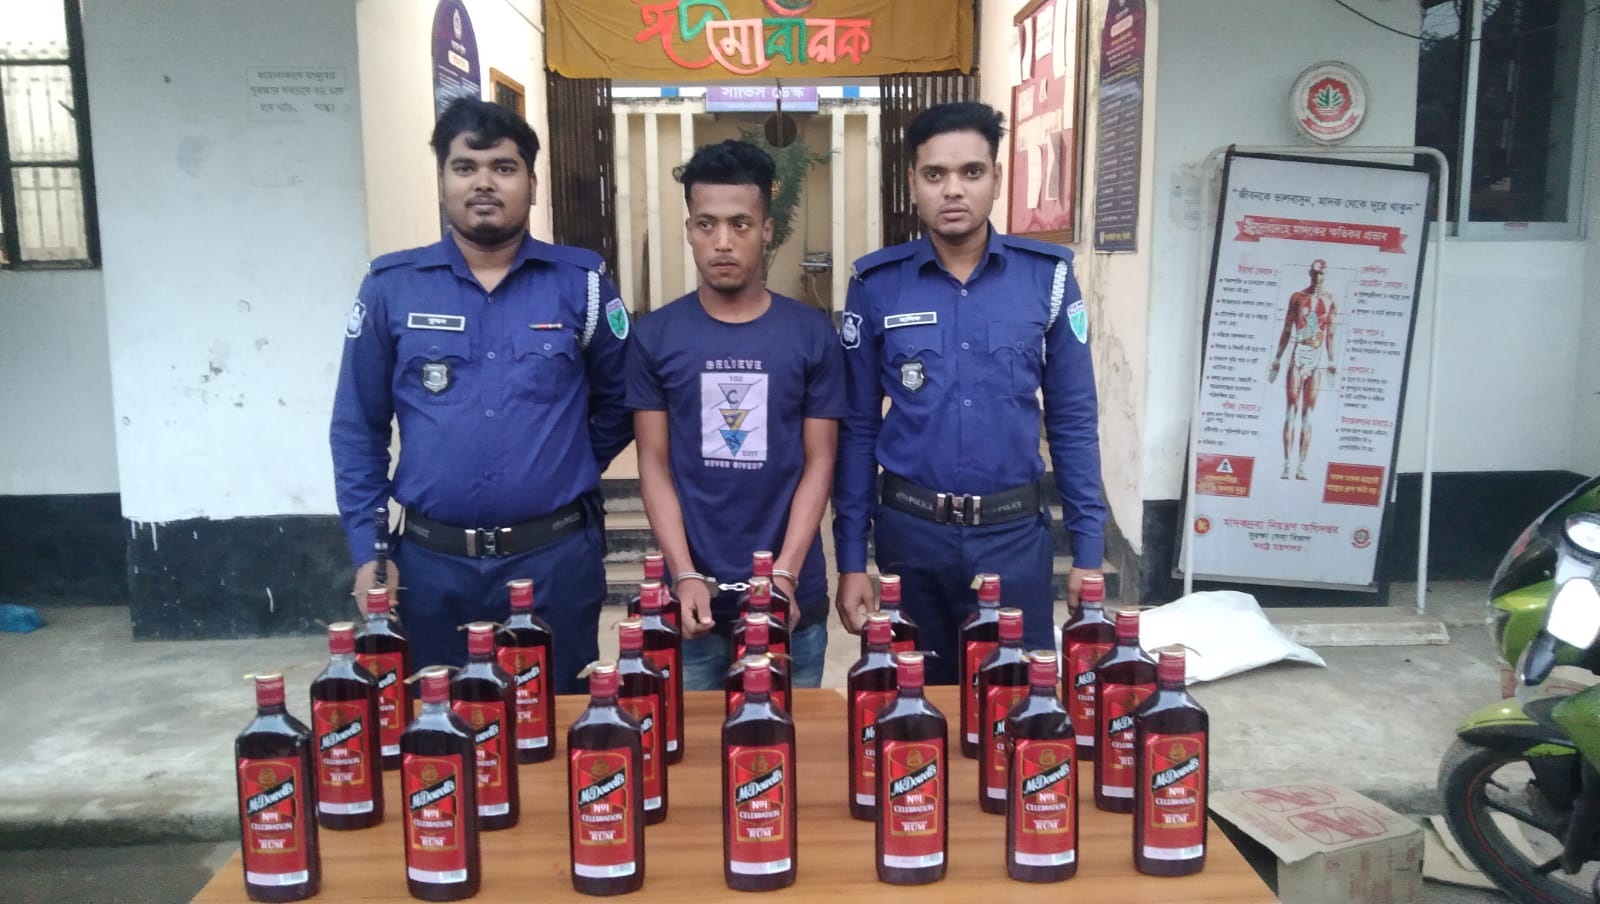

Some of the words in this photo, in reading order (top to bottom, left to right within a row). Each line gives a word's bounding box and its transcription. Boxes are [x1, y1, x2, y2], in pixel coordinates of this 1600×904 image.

[706, 18, 873, 75] মোবারক
[705, 359, 762, 370] BELIEVE
[727, 390, 738, 404] C
[704, 460, 730, 469] NEVER
[323, 757, 360, 766] CELEBRATION
[329, 772, 354, 782] RUM
[1155, 797, 1196, 806] CELEBRATION
[893, 803, 934, 814] CELEBRATION
[1025, 802, 1066, 813] CELEBRATION
[581, 813, 623, 823] CELEBRATION
[739, 809, 780, 820] CELEBRATION
[1162, 814, 1189, 825] RUM
[251, 822, 293, 831] CELEBRATION
[413, 818, 453, 829] CELEBRATION
[901, 821, 927, 832] RUM
[1033, 819, 1060, 830] RUM
[588, 830, 616, 841] RUM
[746, 827, 773, 838] RUM
[257, 839, 286, 849] RUM
[419, 835, 446, 847] RUM
